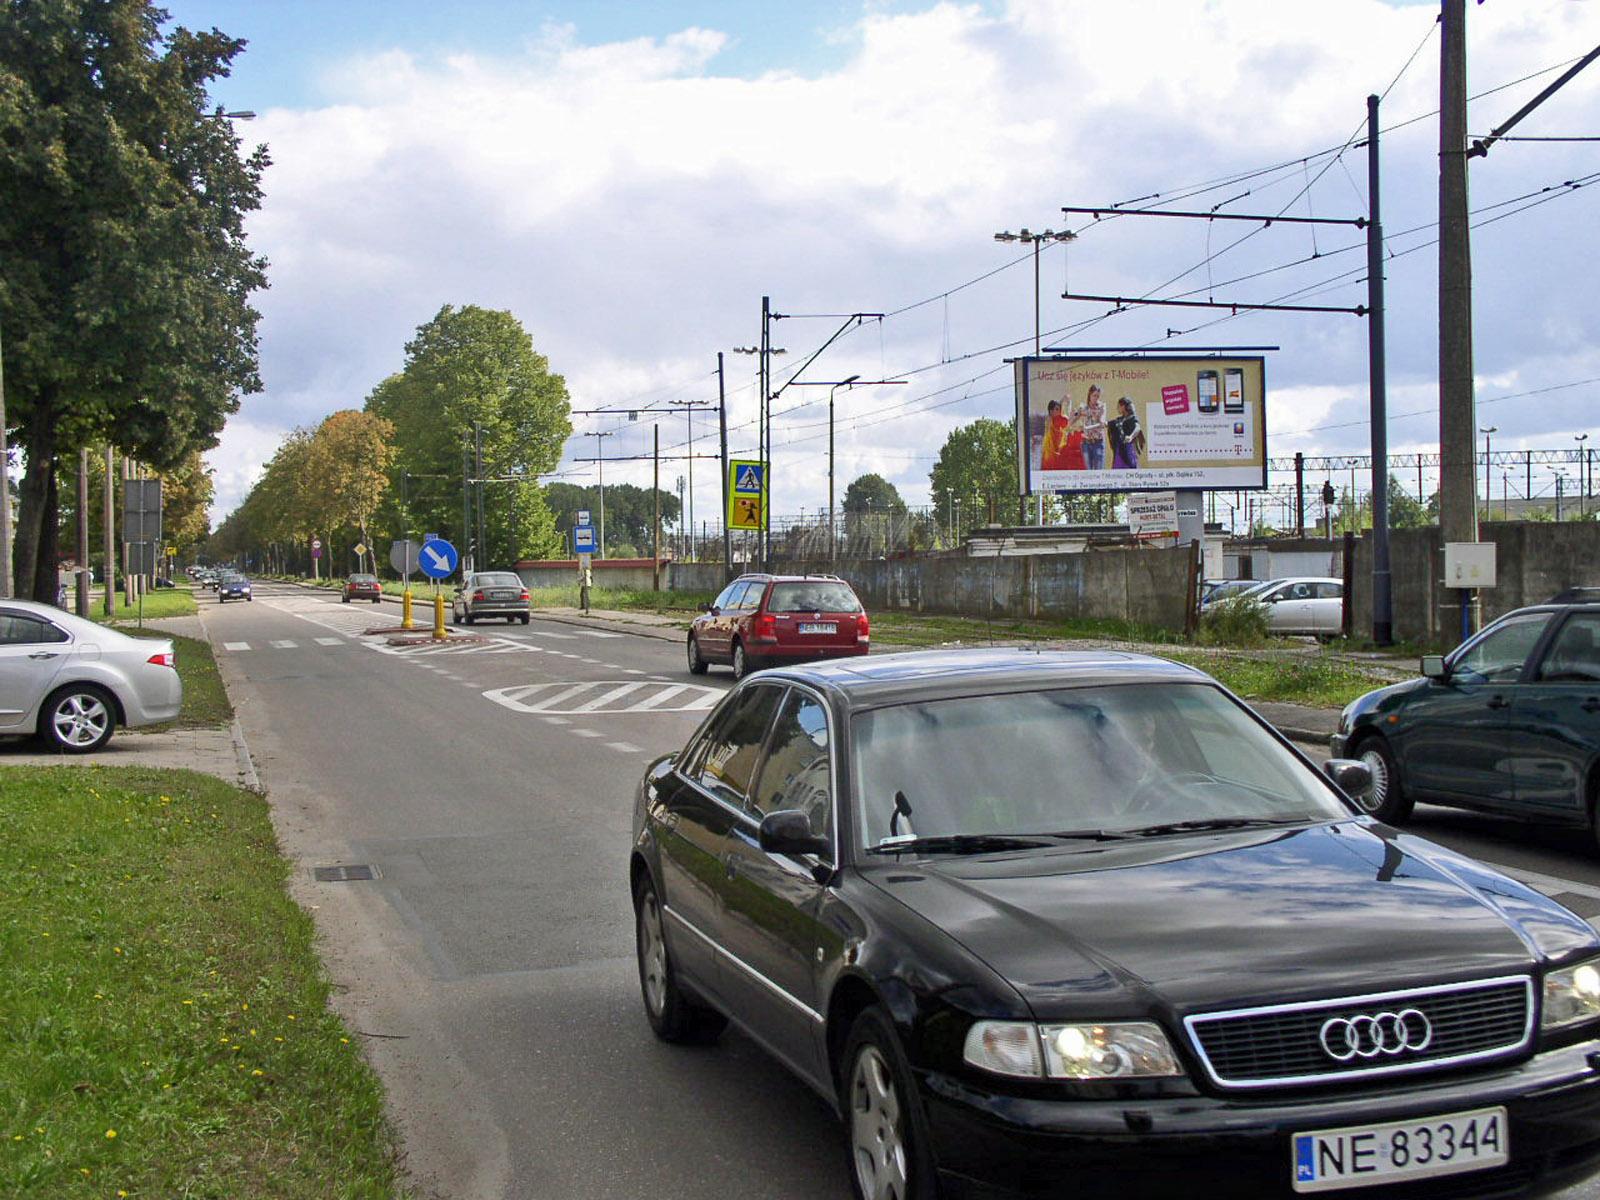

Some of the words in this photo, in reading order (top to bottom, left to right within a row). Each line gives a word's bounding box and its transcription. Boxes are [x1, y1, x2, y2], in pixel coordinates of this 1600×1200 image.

[1069, 370, 1101, 382] języków
[1111, 369, 1150, 380] T-Mobile!
[1318, 1133, 1376, 1176] NE
[1391, 1115, 1500, 1167] 83344
[1297, 1164, 1312, 1176] PL
